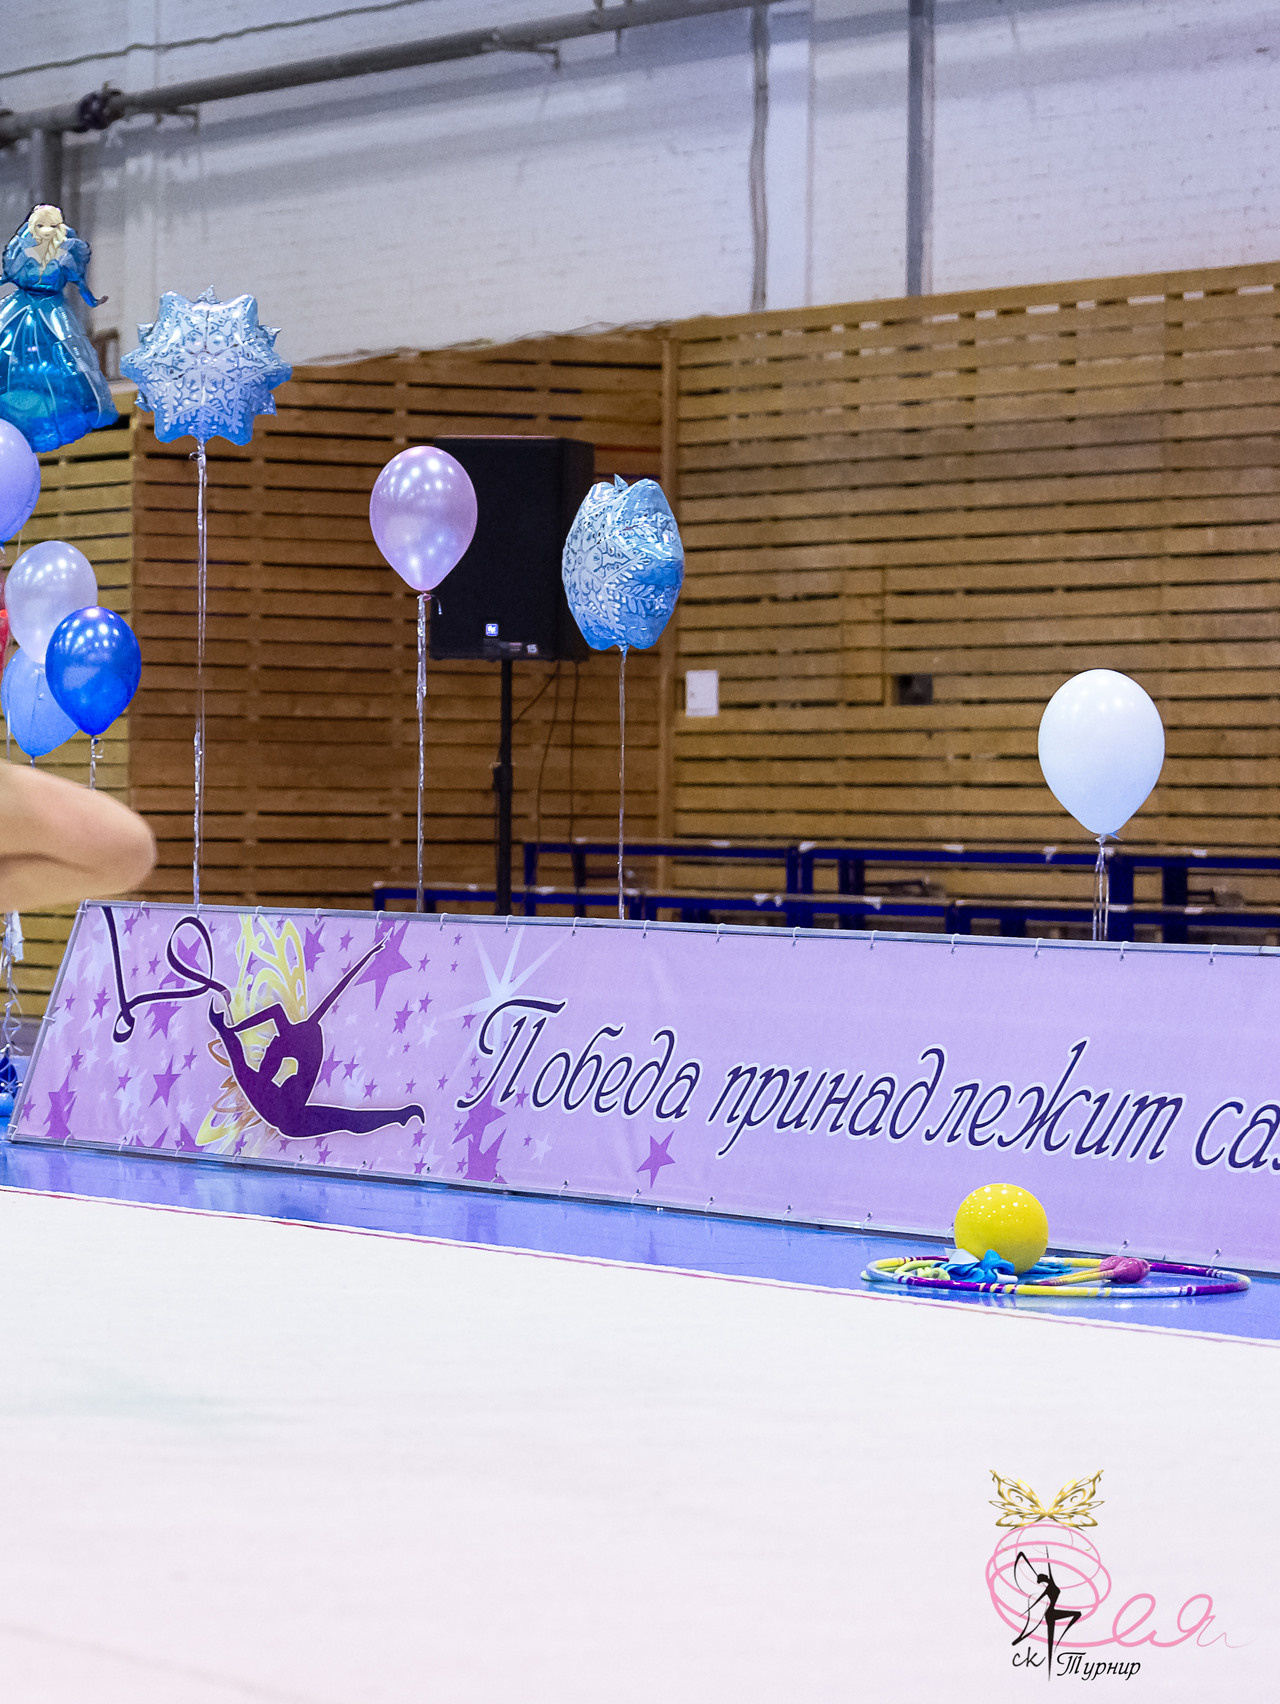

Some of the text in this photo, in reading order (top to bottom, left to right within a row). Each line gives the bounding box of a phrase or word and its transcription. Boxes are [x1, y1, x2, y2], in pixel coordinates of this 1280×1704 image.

[455, 998, 1280, 1171] Победа принадлежит са
